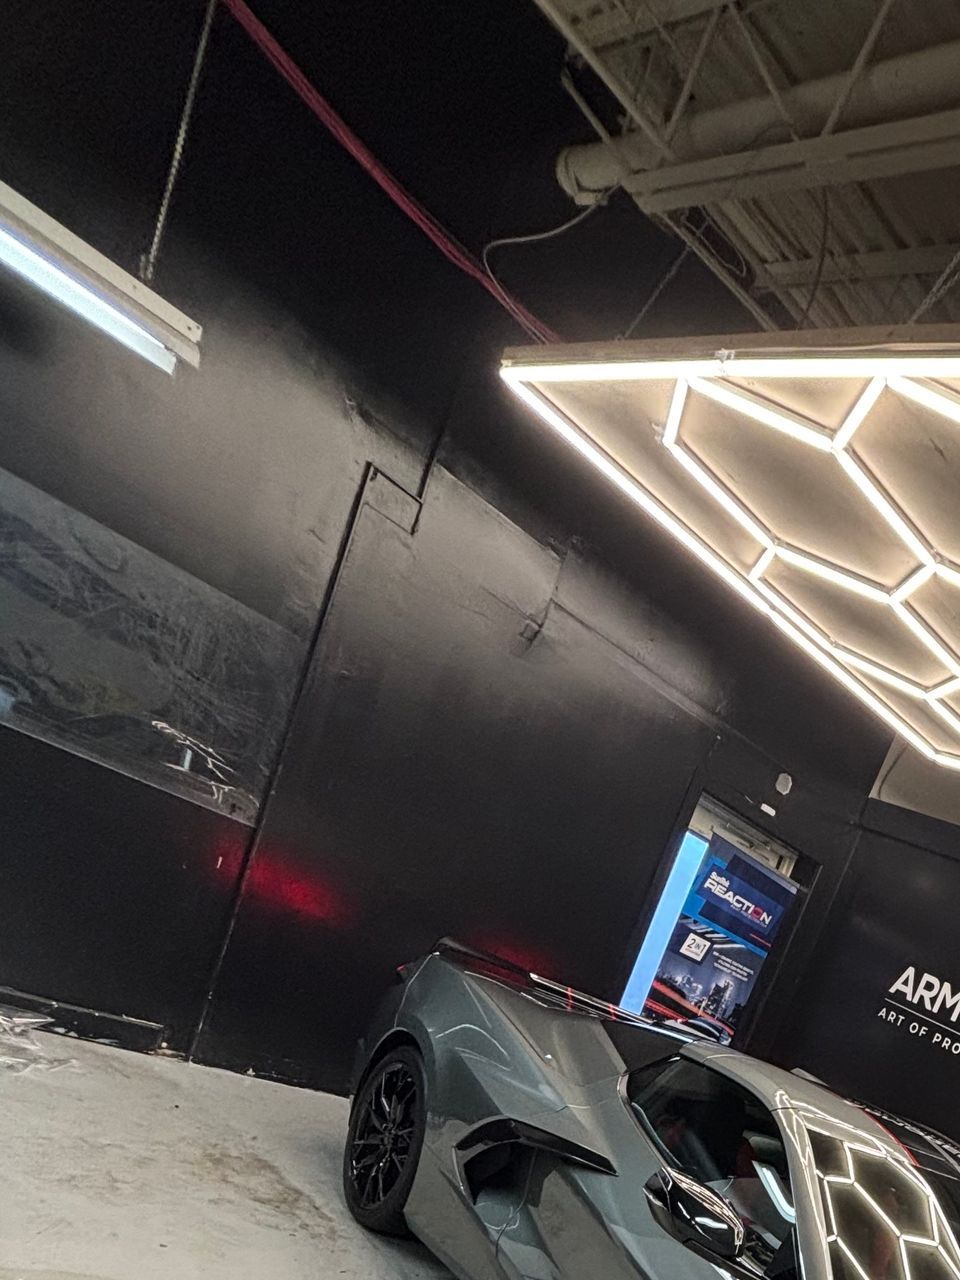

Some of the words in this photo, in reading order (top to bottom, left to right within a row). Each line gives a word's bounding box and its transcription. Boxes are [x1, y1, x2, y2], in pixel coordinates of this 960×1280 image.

[704, 878, 772, 924] REACTION
[687, 938, 696, 949] 2
[700, 943, 707, 954] 1
[878, 1008, 904, 1027] ART
[910, 1023, 928, 1037] OF
